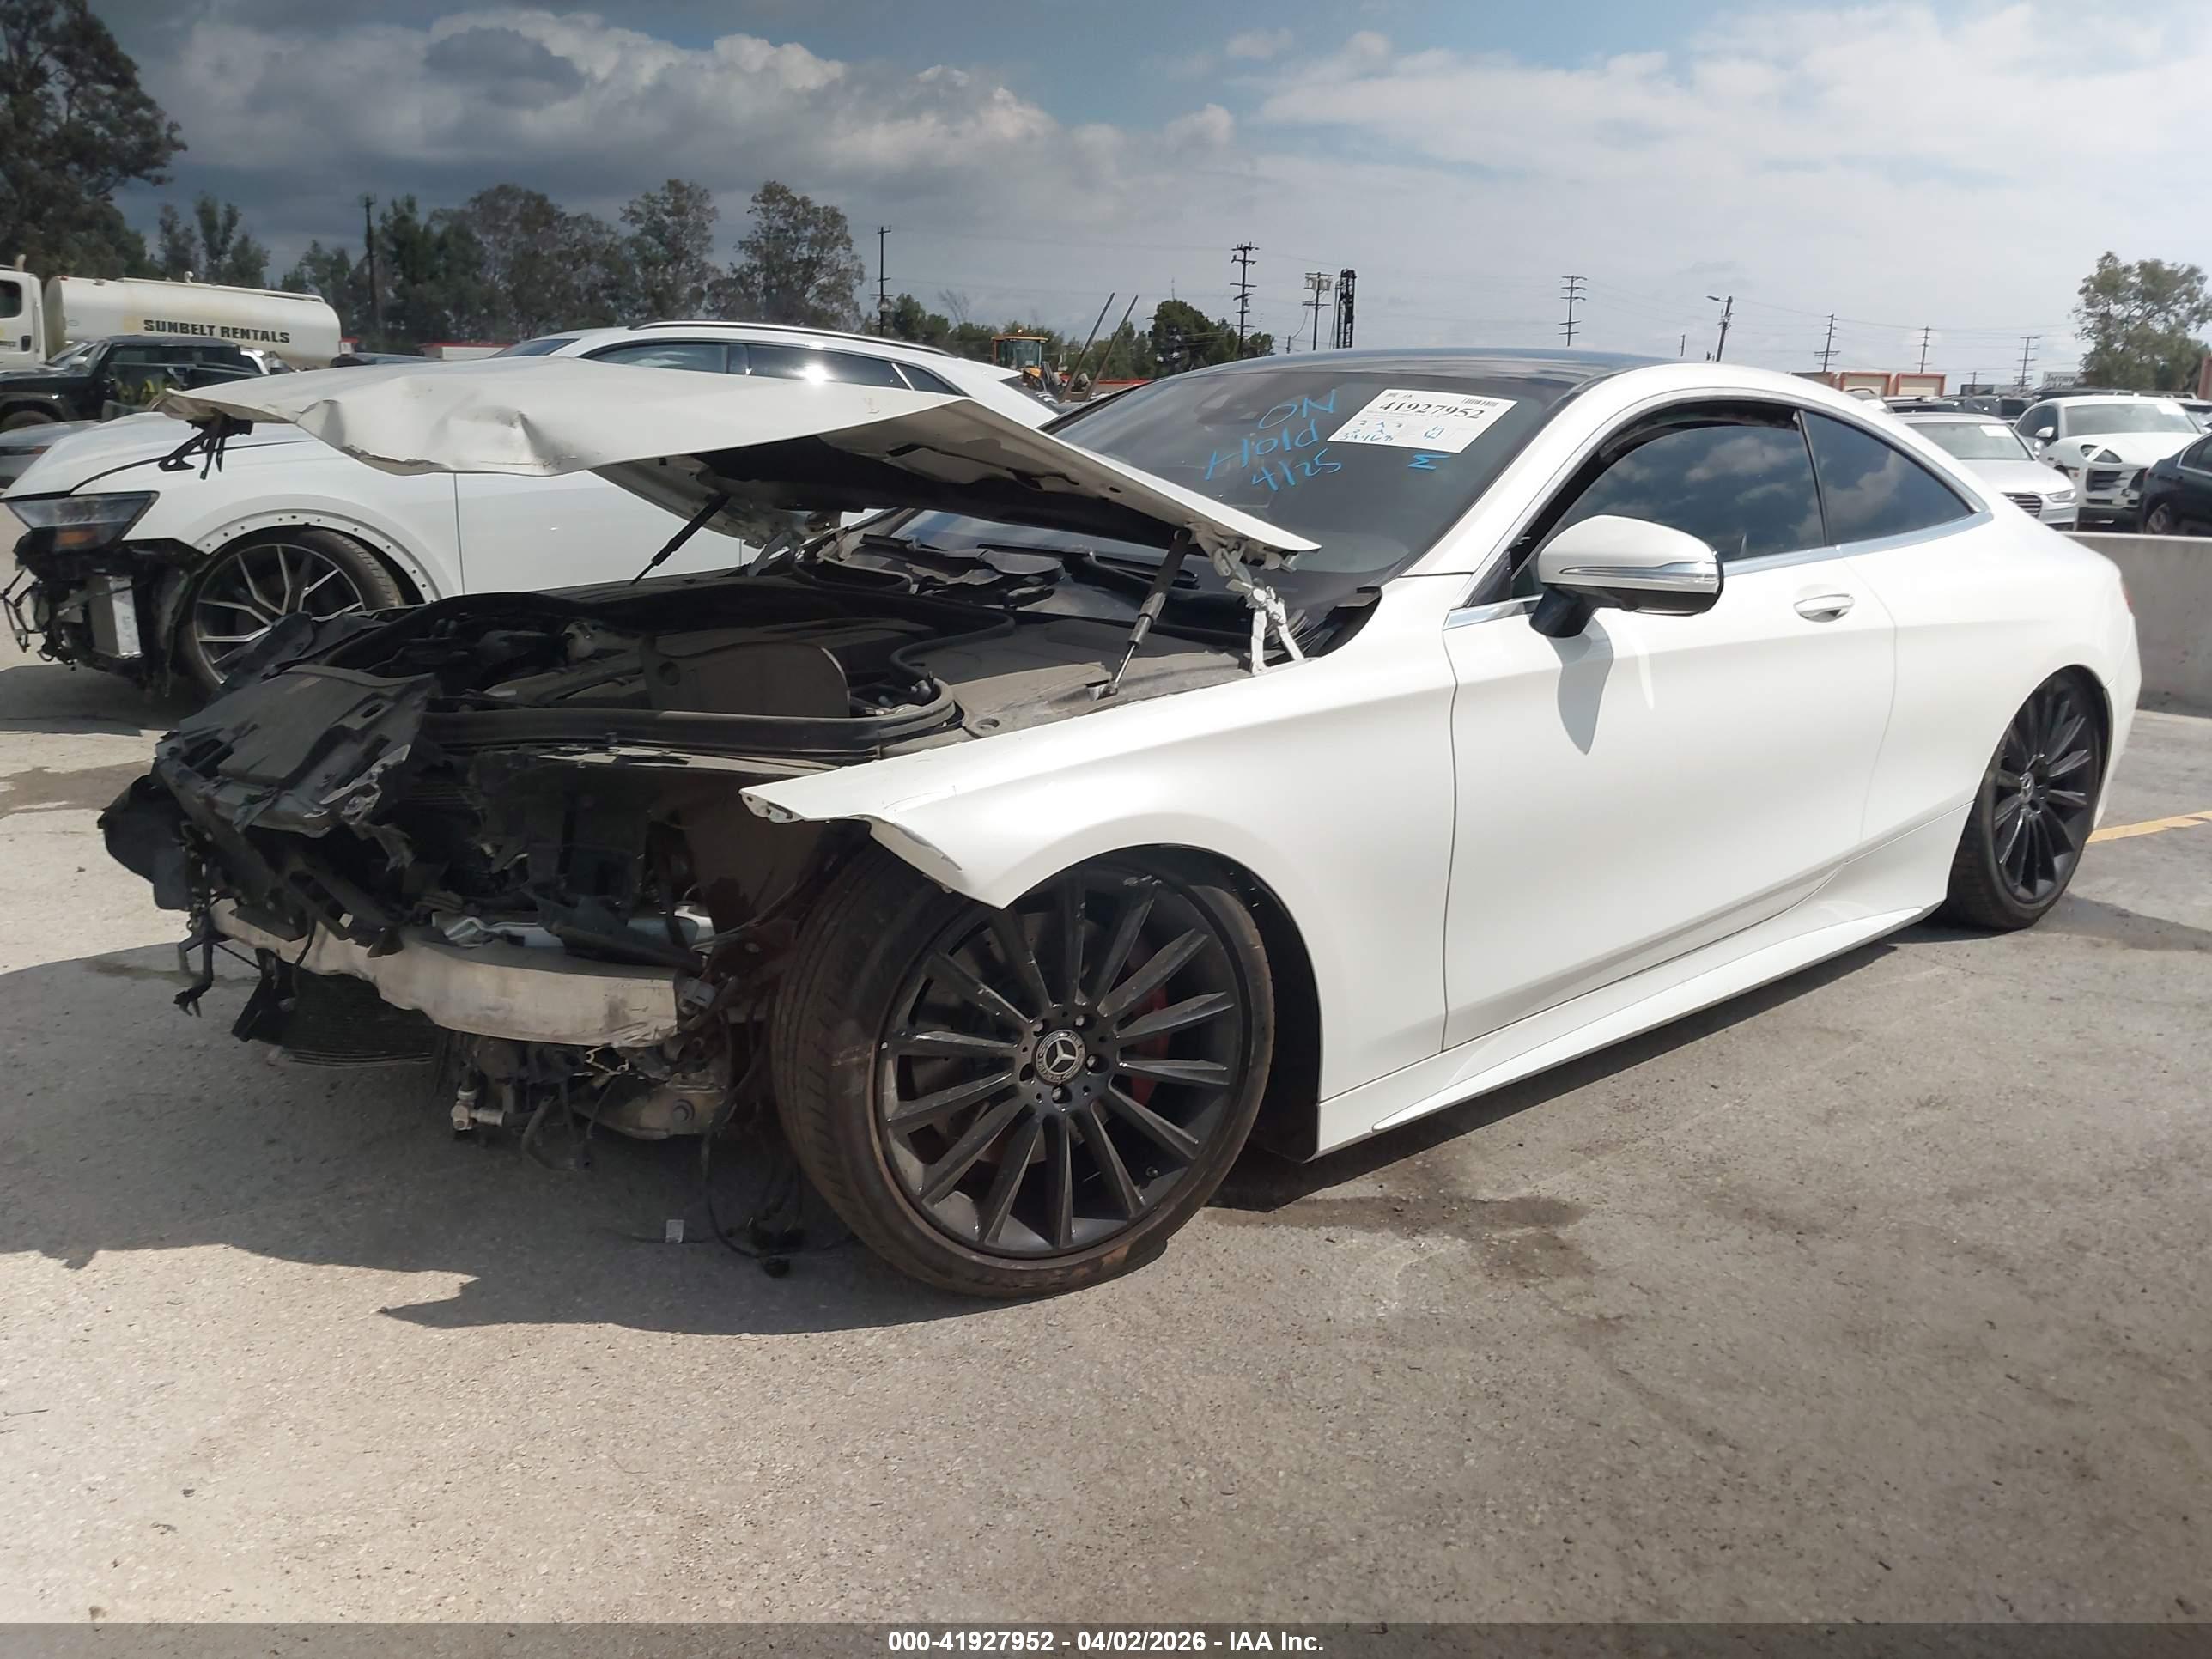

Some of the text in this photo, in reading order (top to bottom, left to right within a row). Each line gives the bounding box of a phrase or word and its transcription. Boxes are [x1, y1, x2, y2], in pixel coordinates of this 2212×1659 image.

[143, 319, 290, 343] SUNBELT RENTALS
[1258, 389, 1337, 429] ON
[1379, 396, 1485, 420] 41927952
